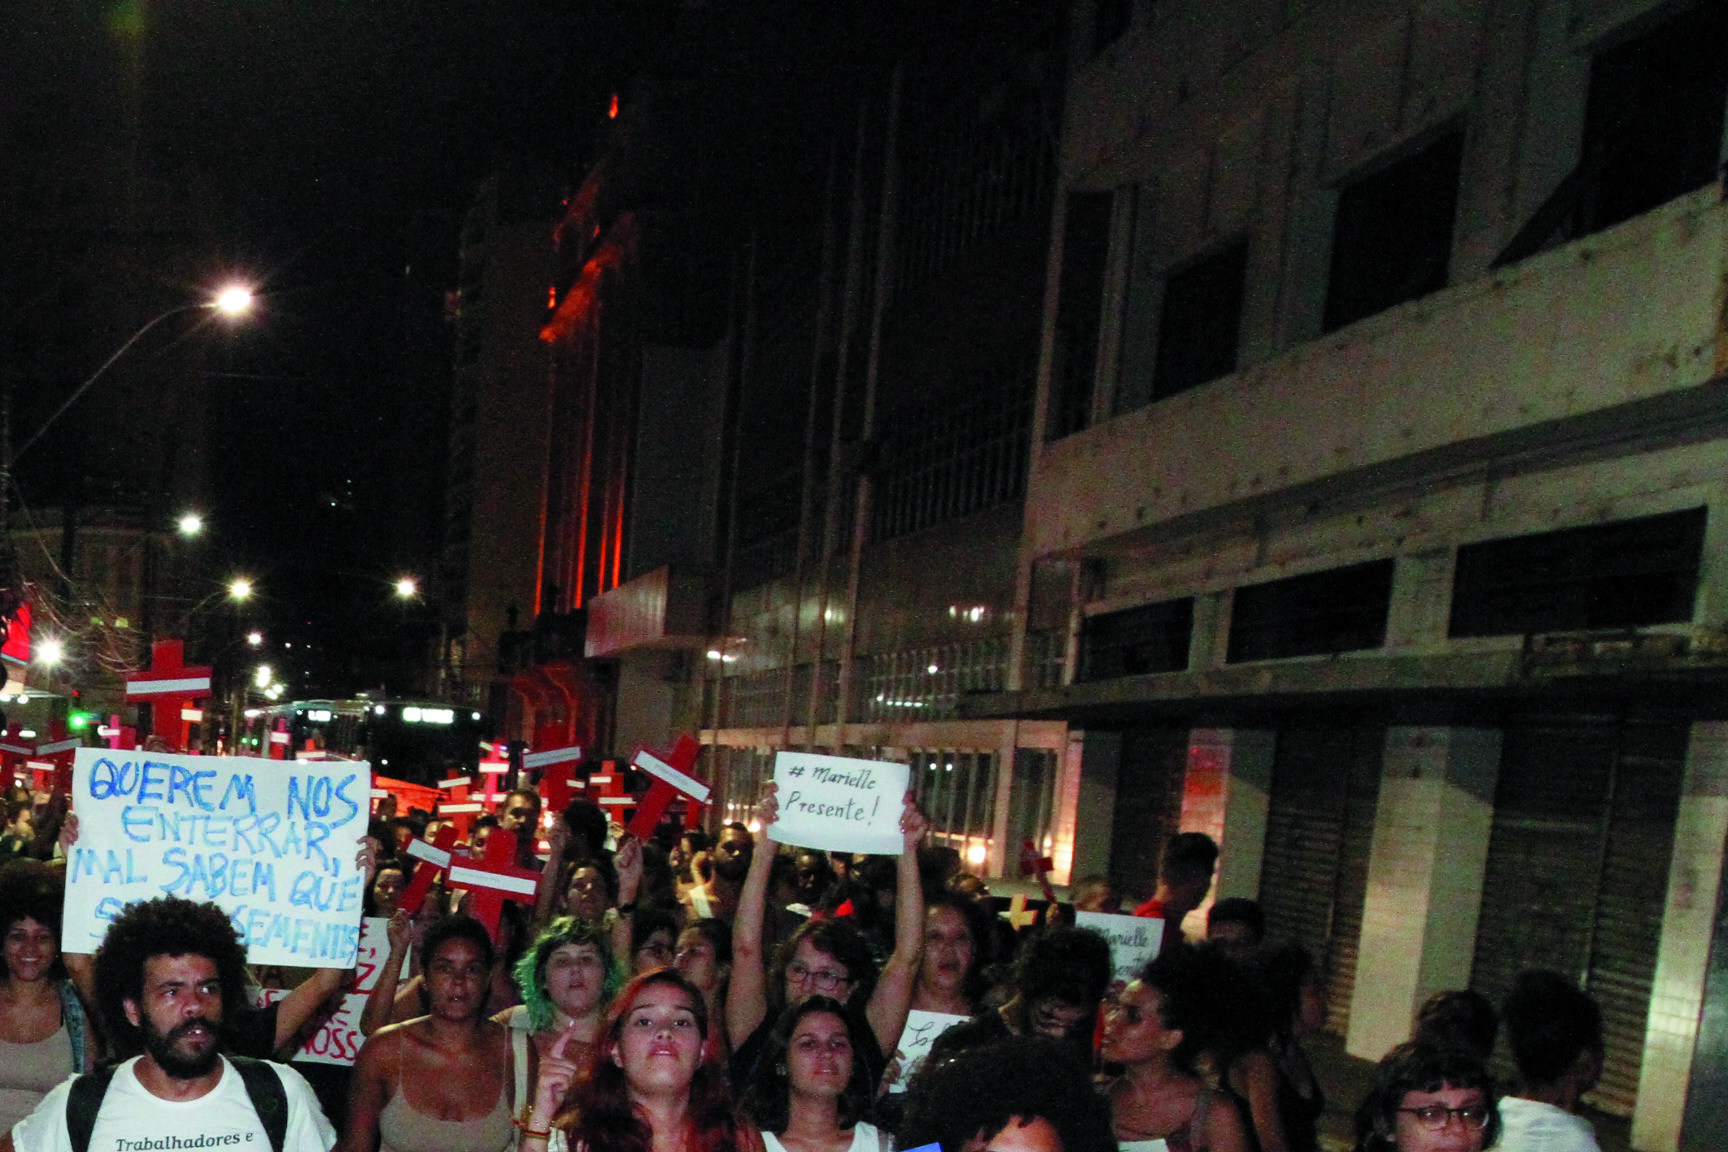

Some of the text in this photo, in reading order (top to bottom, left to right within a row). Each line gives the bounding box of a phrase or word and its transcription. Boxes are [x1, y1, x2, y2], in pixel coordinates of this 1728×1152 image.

[88, 756, 360, 830] QUEREM NOS
[811, 766, 878, 791] Marielle
[72, 847, 362, 912] MAL SABEM QUE
[116, 1131, 254, 1152] Trabalhadores e
